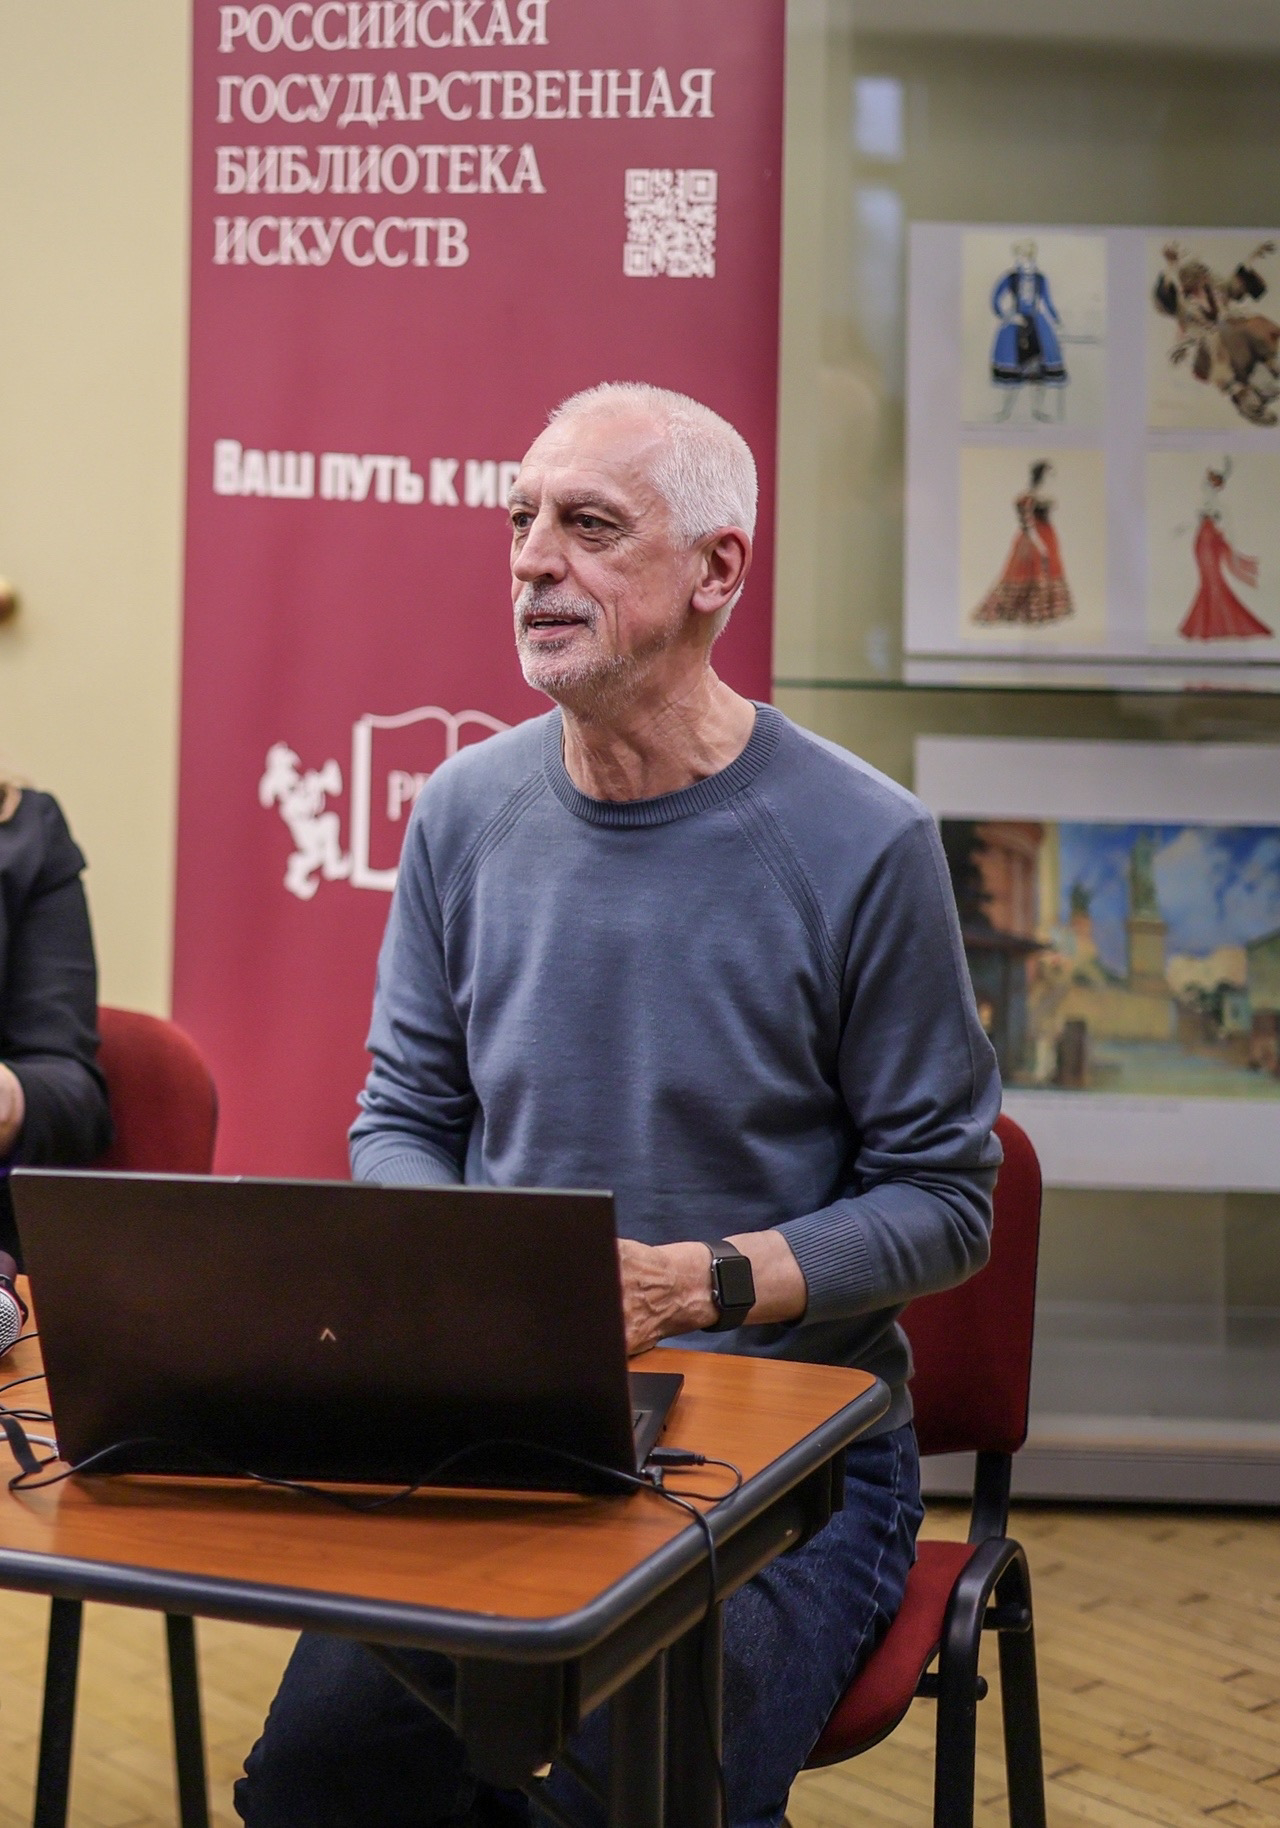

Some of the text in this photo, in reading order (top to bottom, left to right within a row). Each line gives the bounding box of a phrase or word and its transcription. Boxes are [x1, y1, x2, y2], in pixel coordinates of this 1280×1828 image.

[218, 0, 550, 52] РОССИЙСКАЯ
[216, 67, 716, 128] ГОСУДАРСТВЕННАЯ
[215, 144, 546, 194] БИБЛИОТЕКА
[212, 216, 470, 268] ИСКУССТВ
